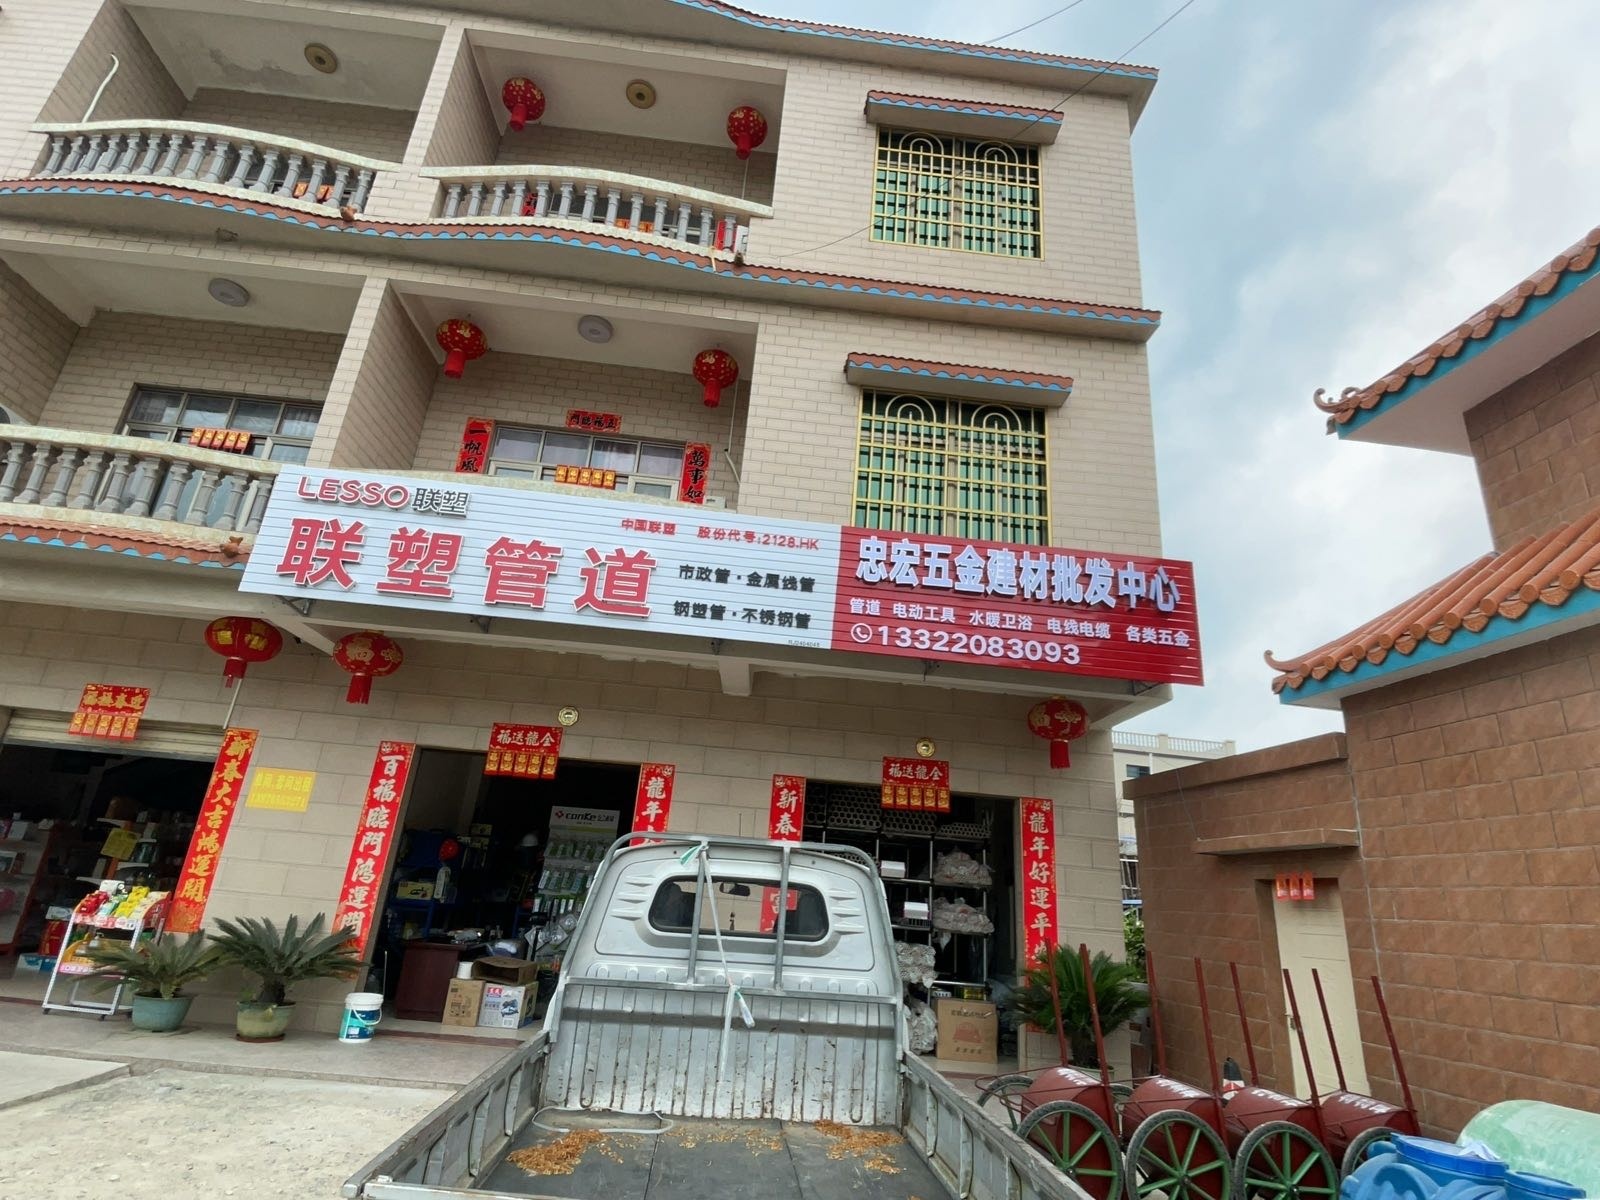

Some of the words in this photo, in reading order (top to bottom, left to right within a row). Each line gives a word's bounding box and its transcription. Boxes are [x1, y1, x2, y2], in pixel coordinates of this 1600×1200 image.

[297, 476, 410, 509] LESSO
[411, 486, 470, 516] 联塑
[685, 450, 706, 503] 萬事如
[275, 517, 657, 618] 联塑管道
[857, 536, 1180, 613] 忠宏五金建材批发中心
[850, 598, 881, 616] 管道
[892, 602, 956, 624] 电动工具
[968, 610, 1033, 631] 水暖卫浴
[1047, 617, 1111, 640] 电线电缆
[1126, 625, 1190, 648] 各类五金
[879, 624, 1081, 666] 13322083093
[774, 788, 799, 840] 新春
